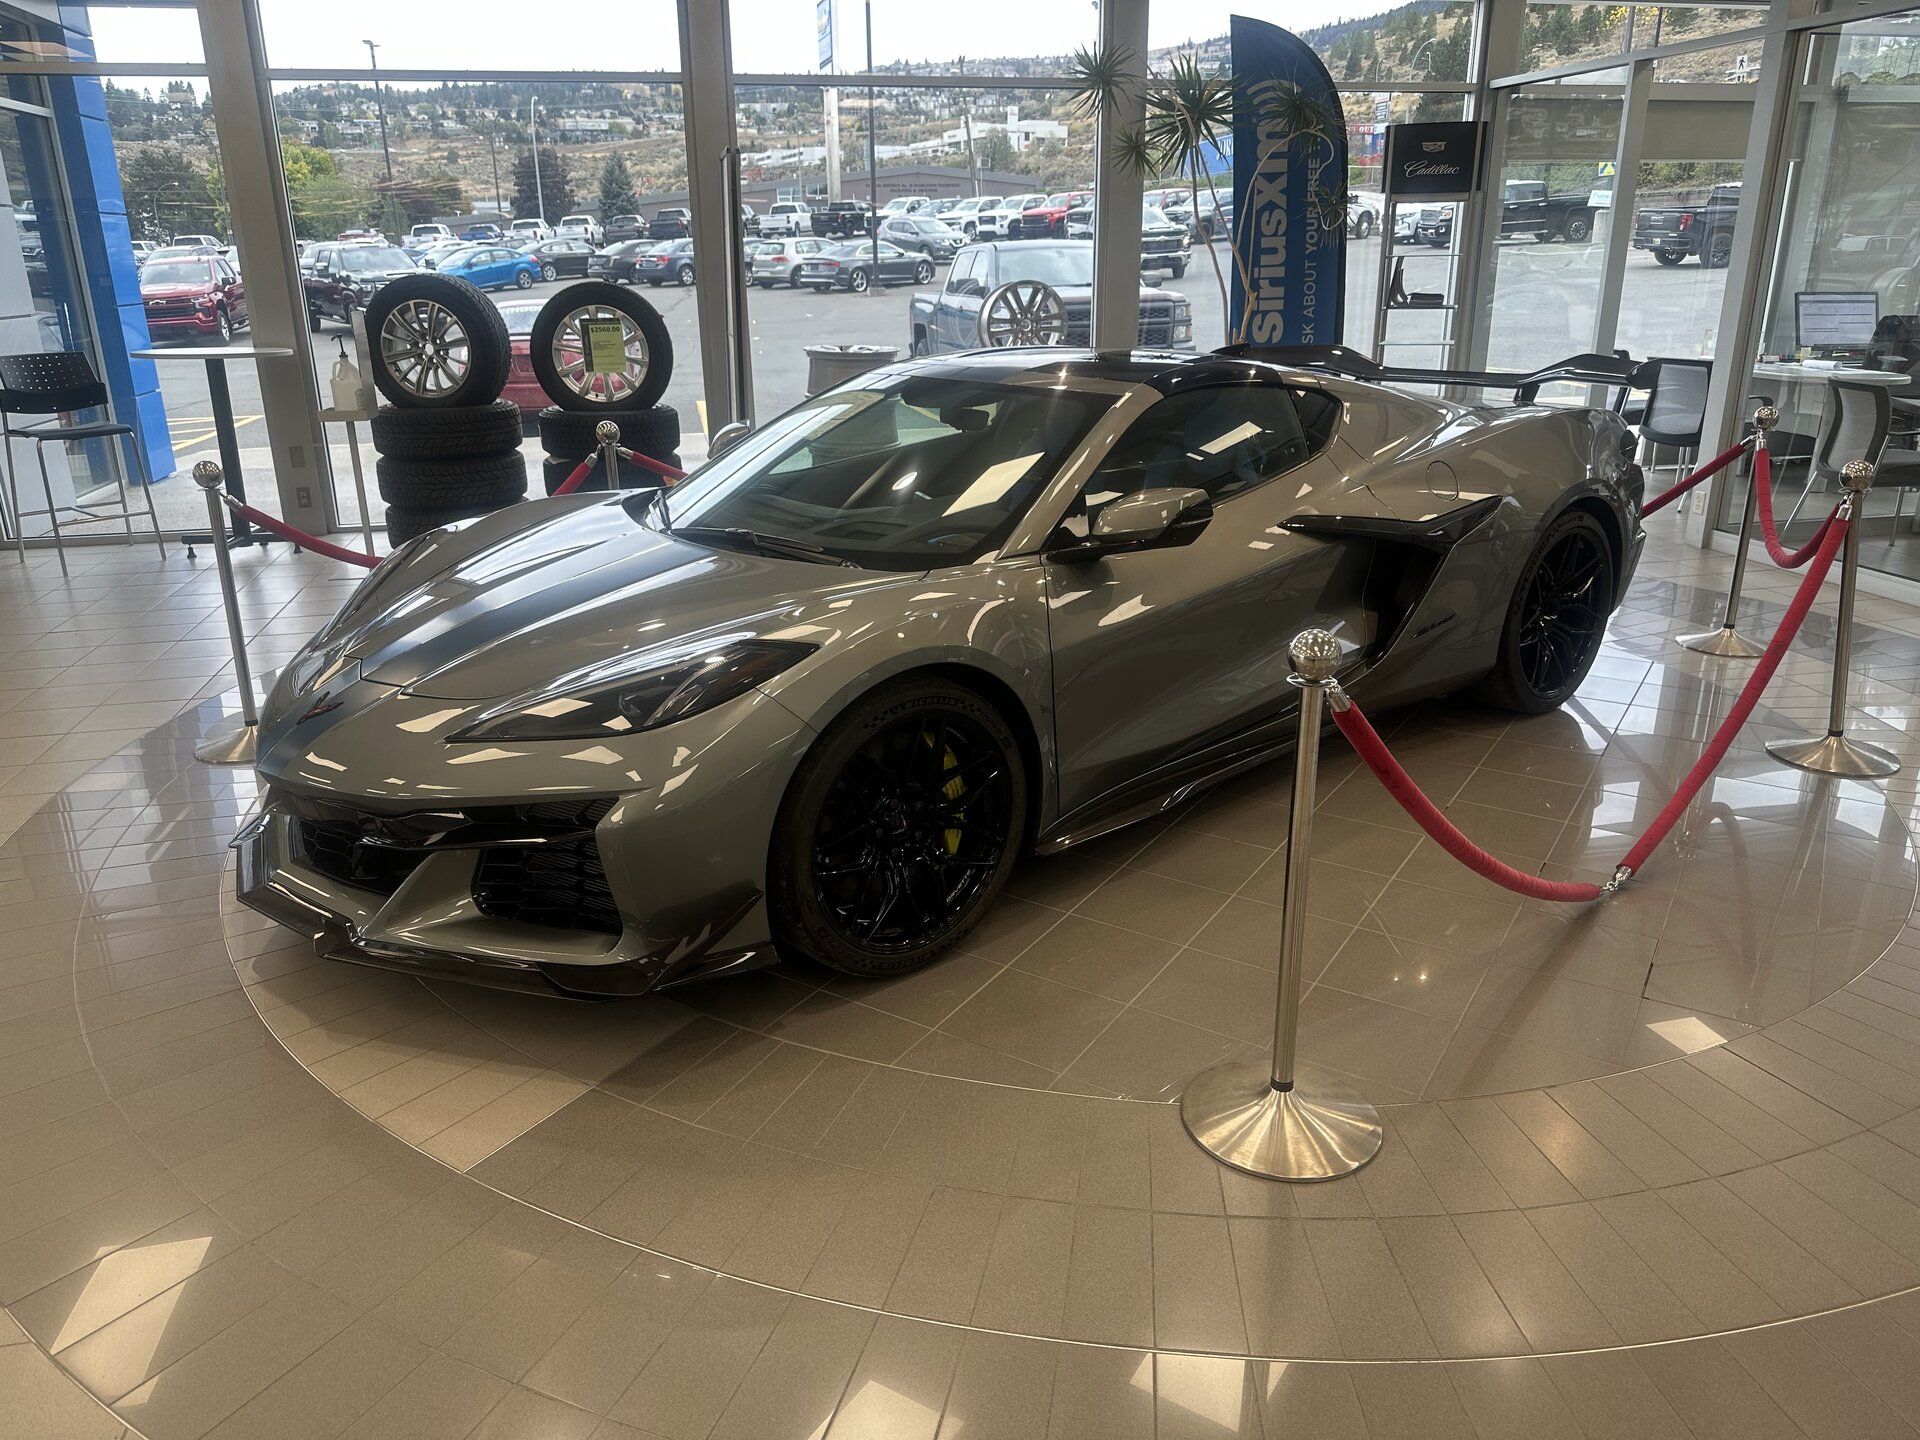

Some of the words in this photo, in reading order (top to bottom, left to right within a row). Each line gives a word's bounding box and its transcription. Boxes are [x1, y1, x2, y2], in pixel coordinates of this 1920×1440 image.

[1306, 158, 1320, 202] FREE
[1404, 160, 1460, 178] Cadillac
[1305, 207, 1319, 254] YOUR
[1303, 261, 1317, 319] ABOUT
[1302, 323, 1314, 344] SK
[904, 696, 958, 710] MICHELIN
